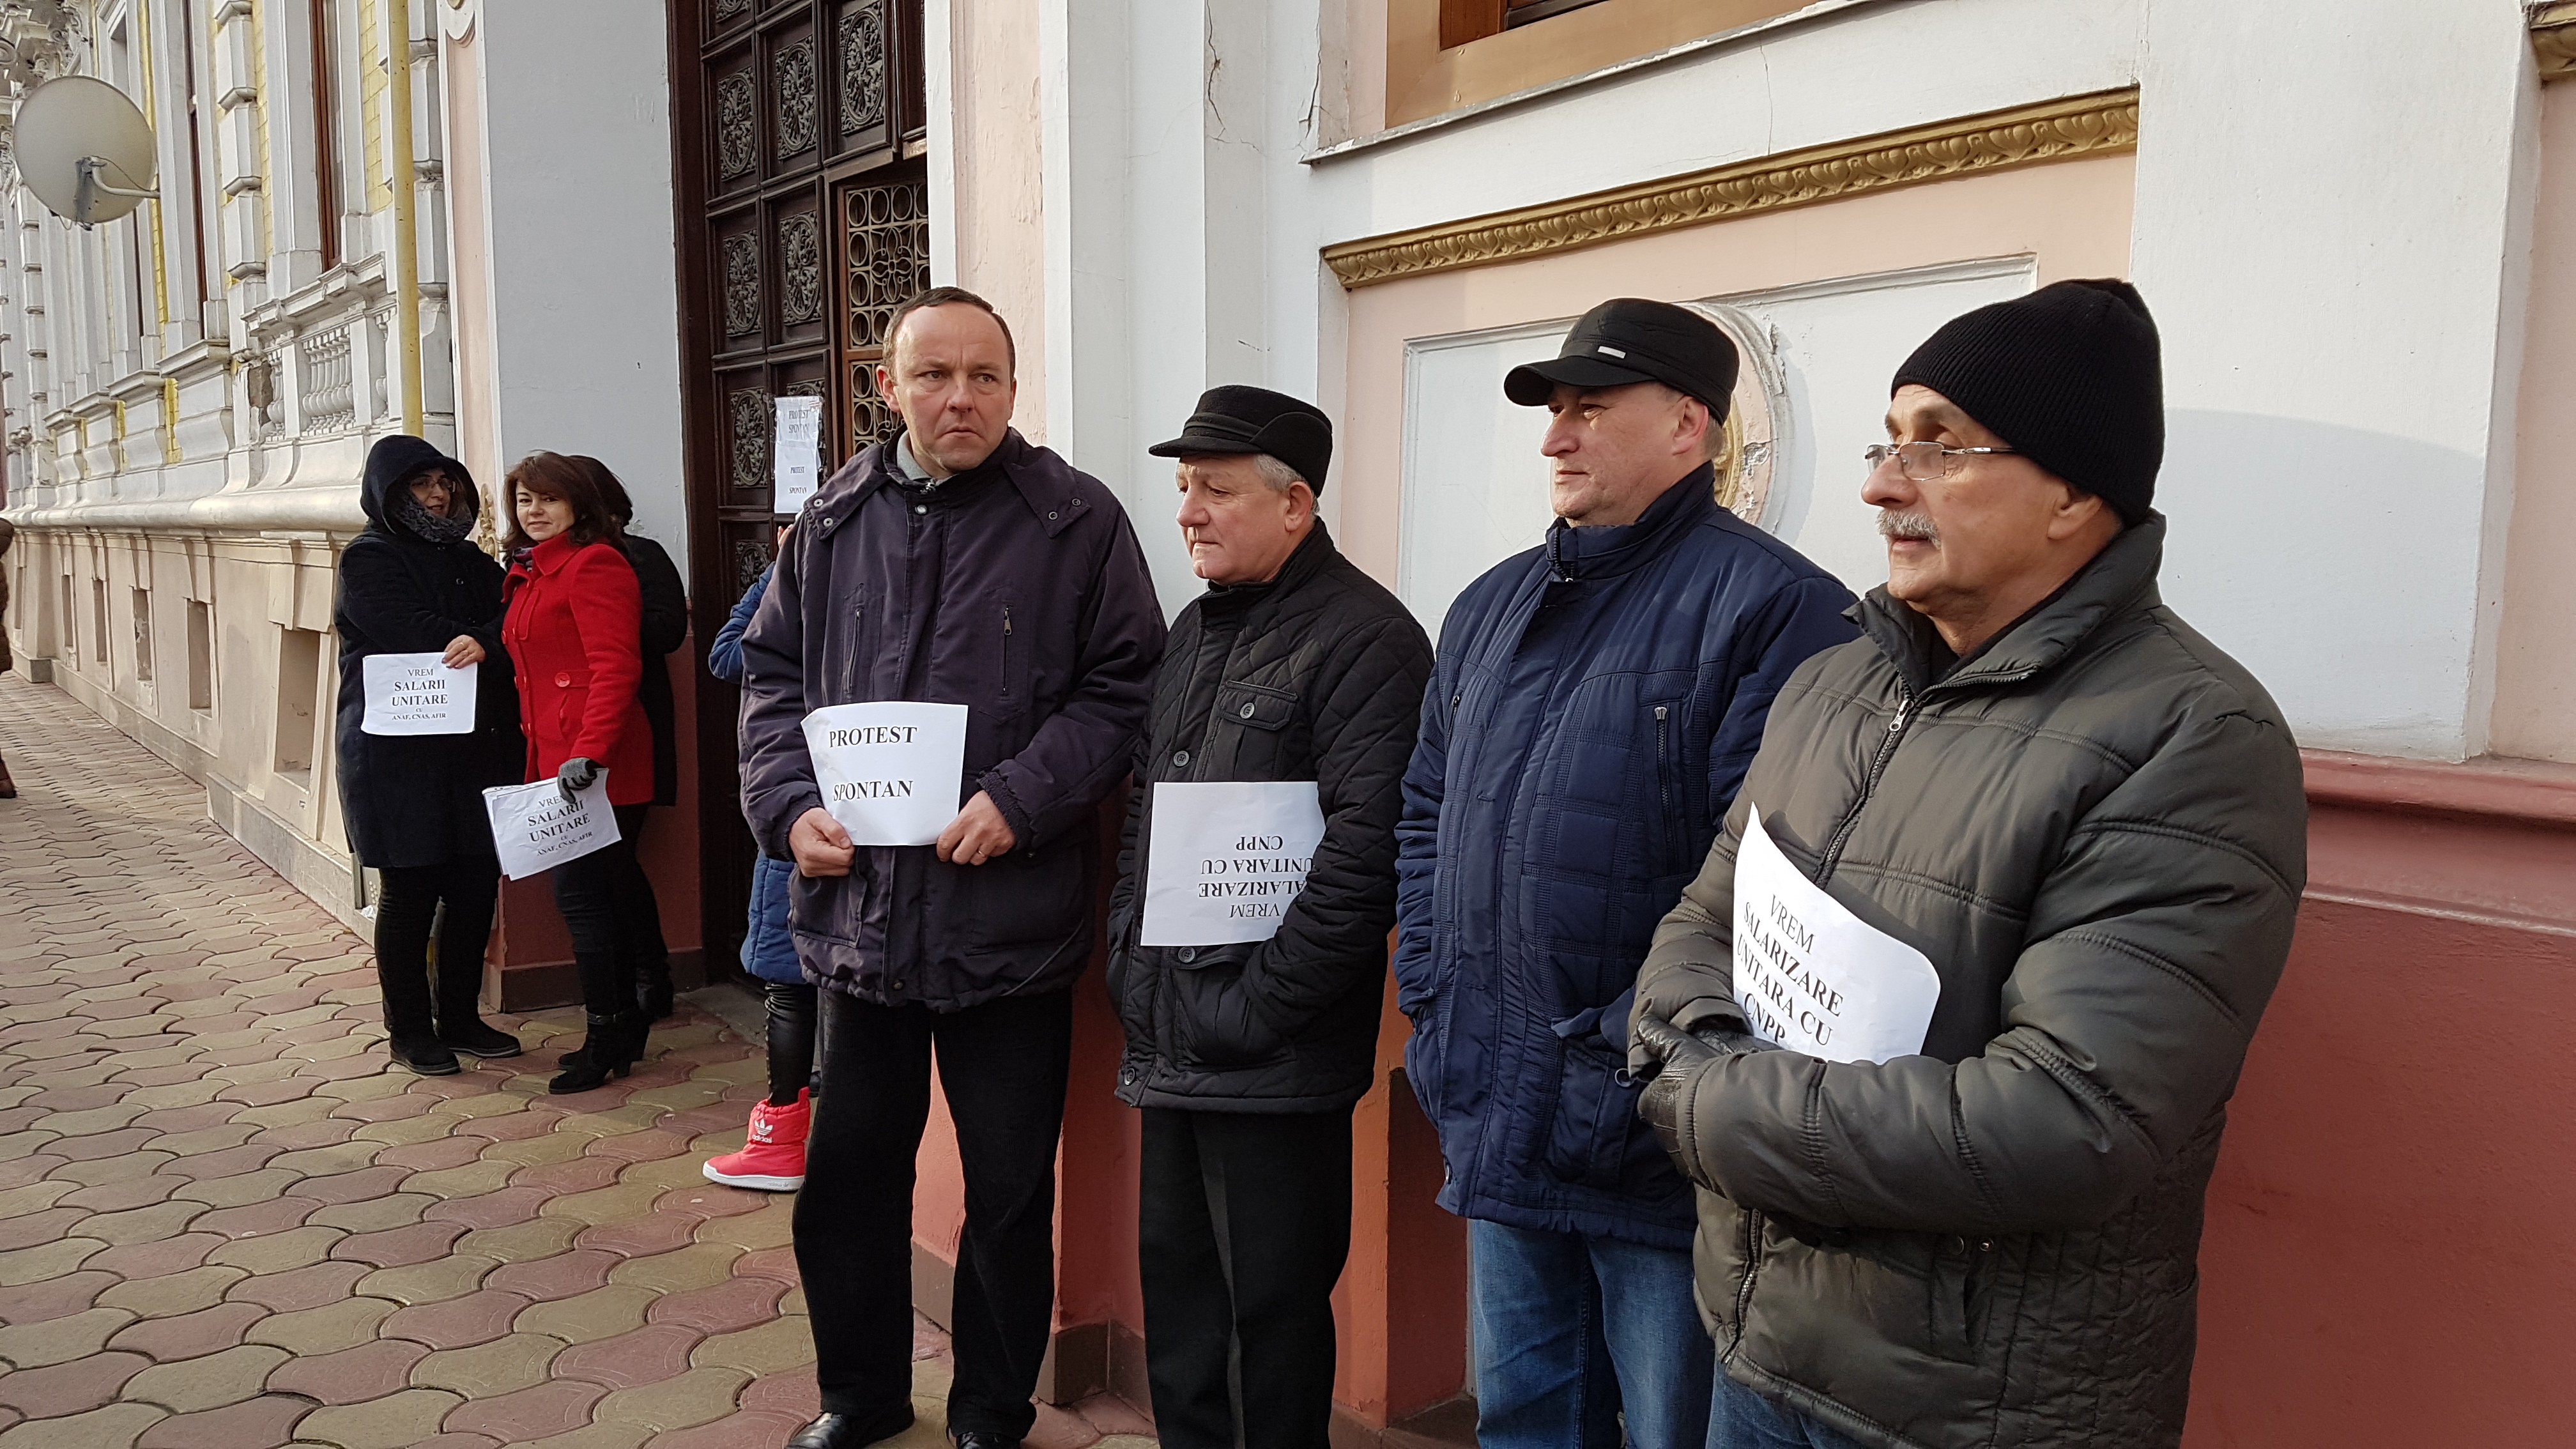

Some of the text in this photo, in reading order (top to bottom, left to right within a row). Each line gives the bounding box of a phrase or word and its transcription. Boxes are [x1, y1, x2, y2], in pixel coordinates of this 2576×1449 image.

[394, 679, 445, 691] SALARII
[392, 694, 448, 706] UNITARE
[829, 726, 917, 748] PROTEST
[834, 780, 914, 801] SPONTAN
[538, 795, 564, 808] VRE
[528, 799, 584, 826] SALARII
[529, 813, 590, 841] UNITARE
[1236, 836, 1283, 850] CNPP
[1201, 858, 1314, 875] UNITARA CU
[1199, 881, 1305, 898] ALARIZARE
[1229, 903, 1280, 918] VREM
[1770, 894, 1816, 954] VREM
[1744, 901, 1844, 1017] SALARIZARE
[1736, 933, 1834, 1046] UNITARA CU
[1744, 993, 1786, 1045] CNPP
[752, 1135, 772, 1143] adidas
